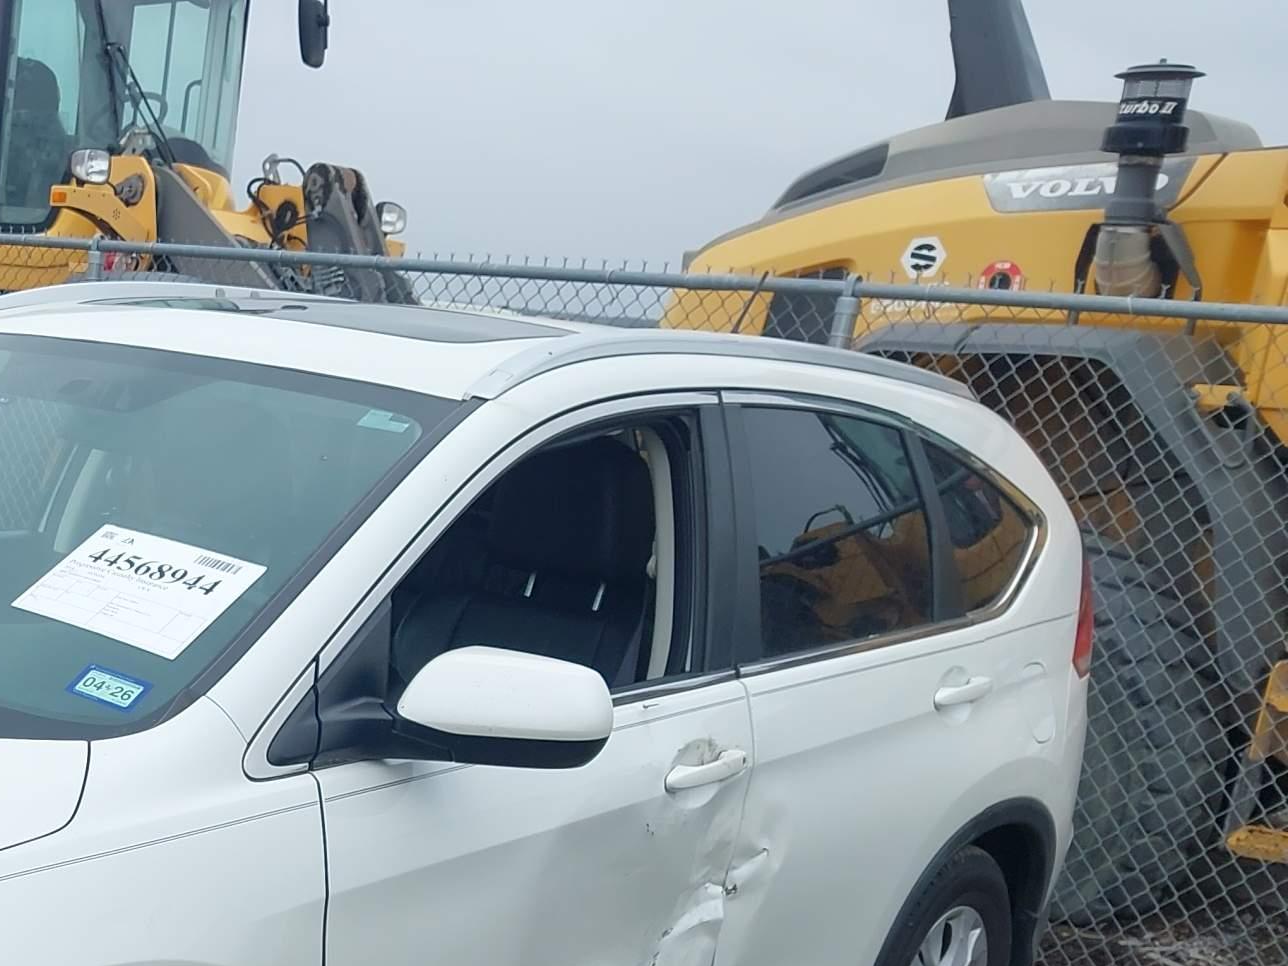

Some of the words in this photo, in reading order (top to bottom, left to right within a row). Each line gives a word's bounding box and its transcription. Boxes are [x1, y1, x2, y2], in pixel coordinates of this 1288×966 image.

[1119, 101, 1159, 115] turbo
[88, 548, 223, 595] 44568944
[82, 676, 106, 691] 04
[109, 686, 134, 701] 26
